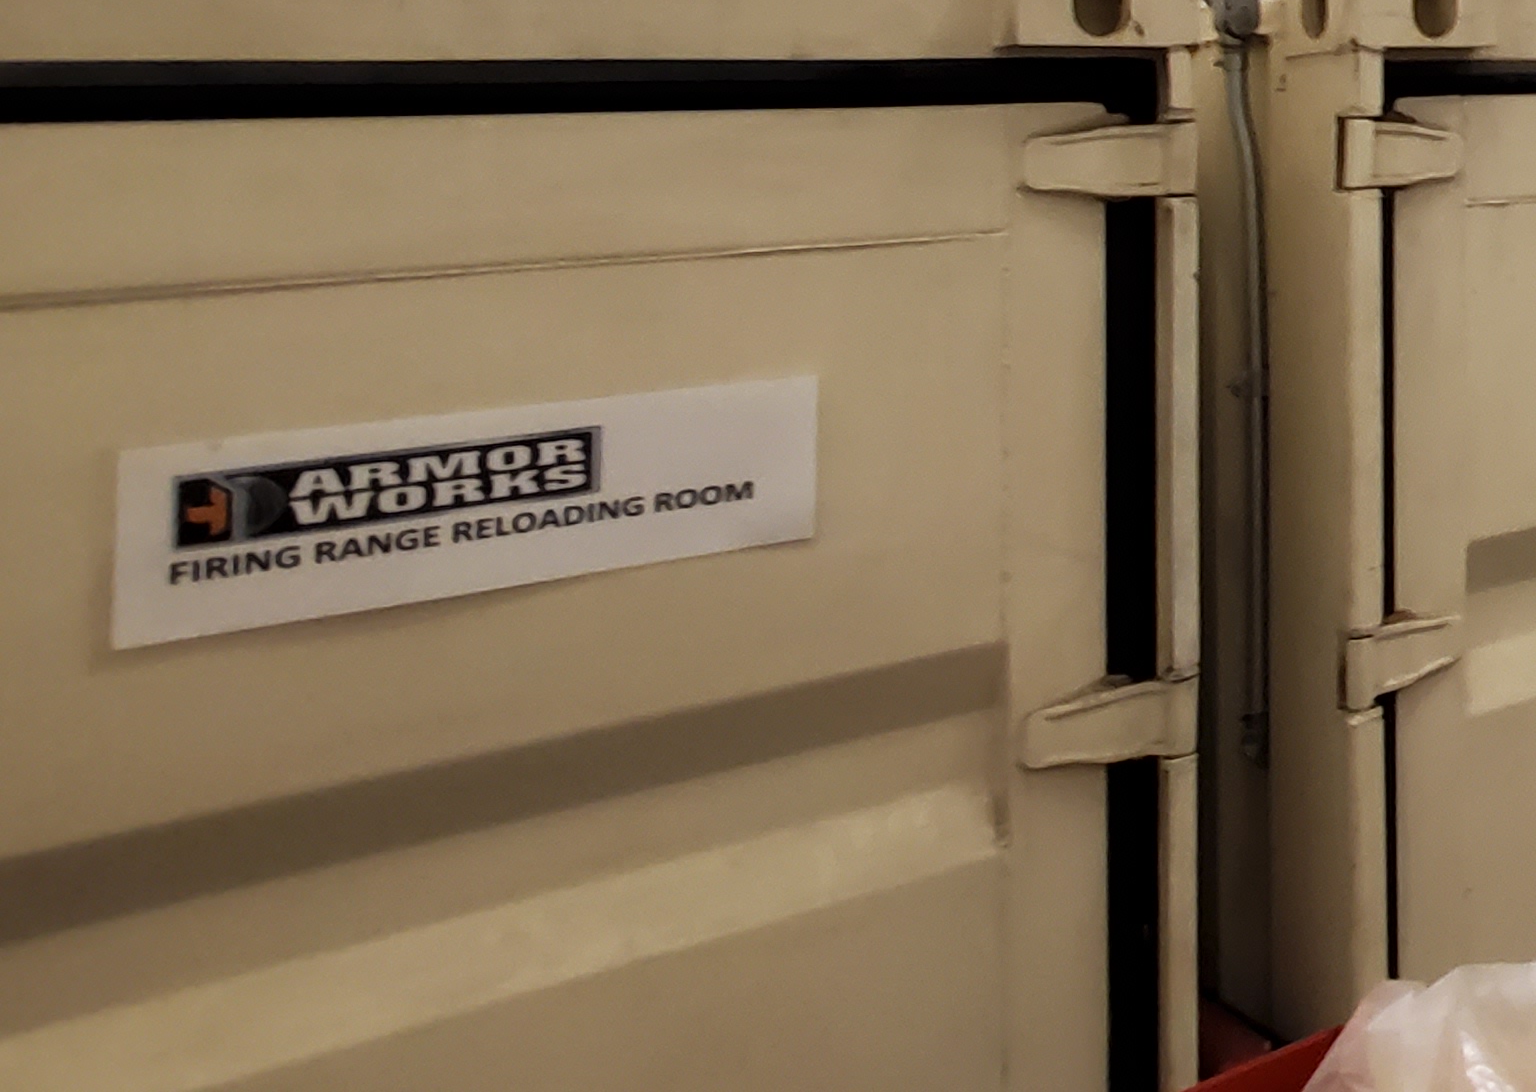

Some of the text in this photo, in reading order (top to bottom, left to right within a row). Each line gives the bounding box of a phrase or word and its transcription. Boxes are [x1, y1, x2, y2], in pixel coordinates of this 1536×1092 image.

[288, 438, 584, 499] ARMOR
[289, 464, 588, 525] WORKS
[169, 480, 754, 585] FIRING RANGE RELOADING ROOM
